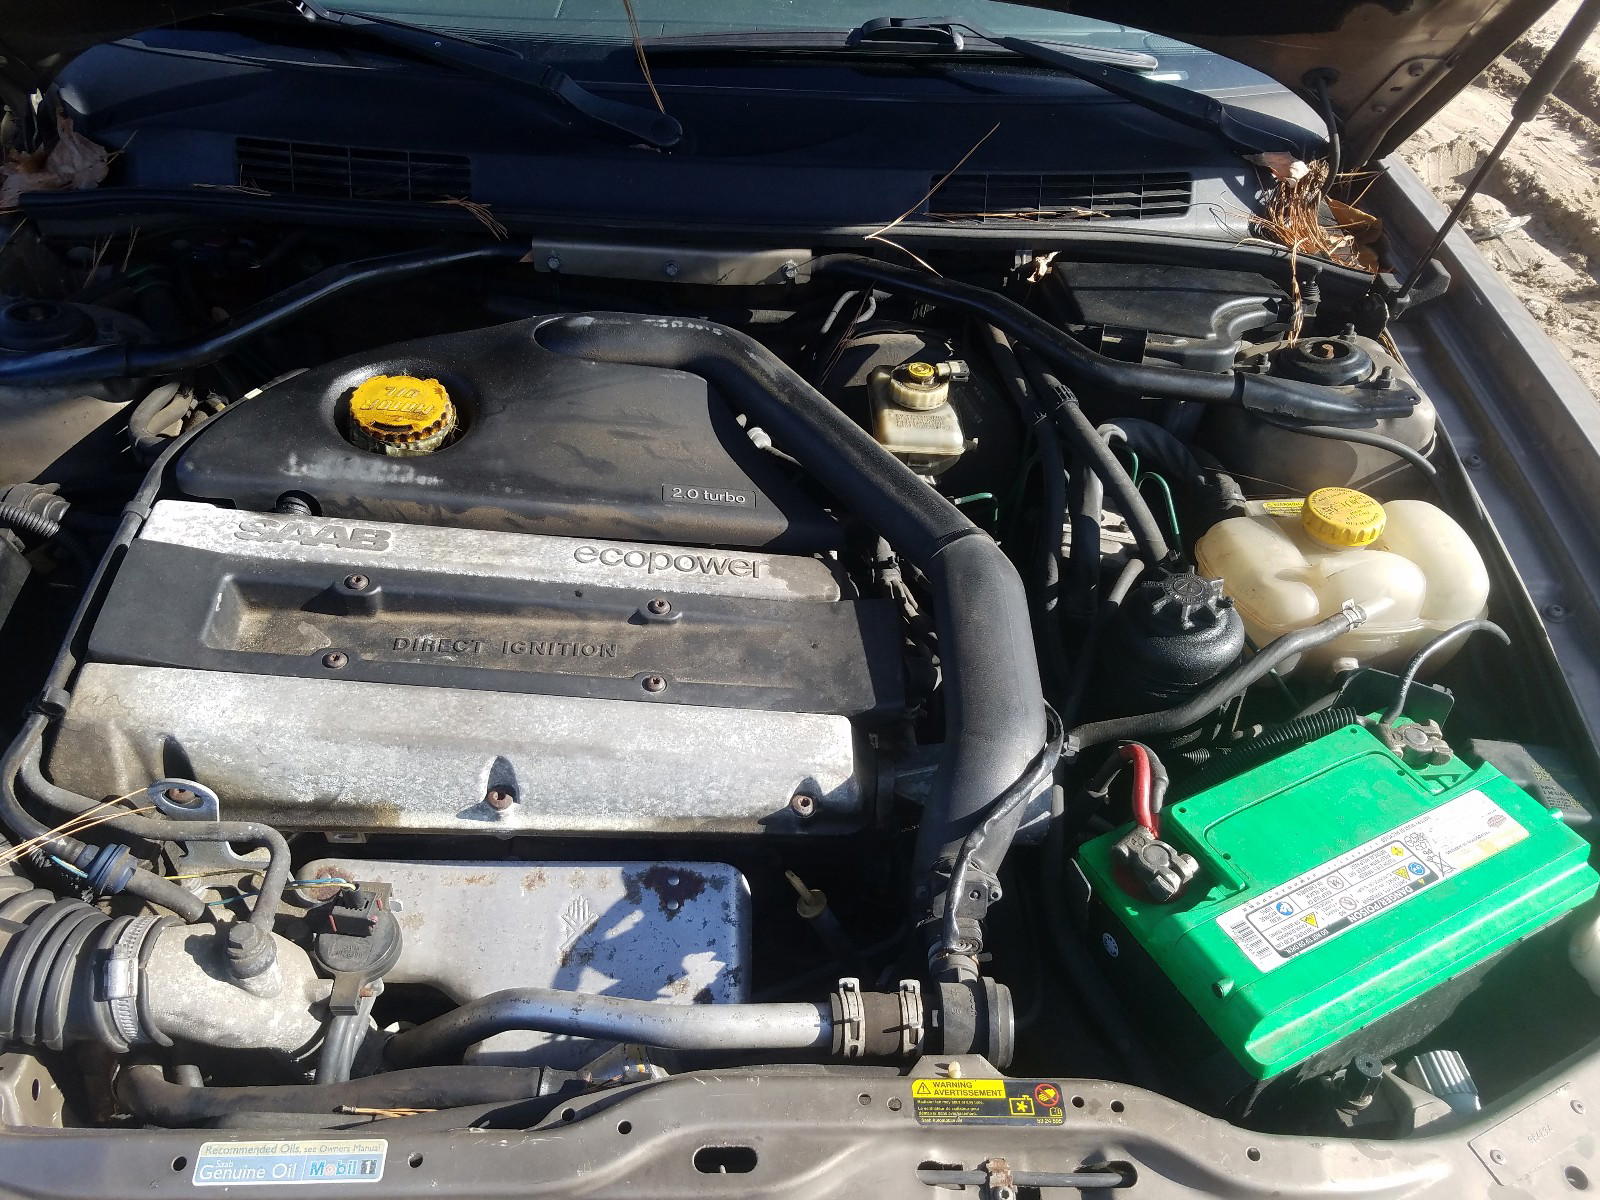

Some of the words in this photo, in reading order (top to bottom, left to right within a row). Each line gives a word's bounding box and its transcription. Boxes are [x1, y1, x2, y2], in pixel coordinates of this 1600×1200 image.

[672, 487, 699, 499] 2.0
[704, 490, 746, 503] turbo
[233, 518, 392, 551] SAAB
[573, 545, 763, 579] ecopower
[393, 637, 485, 654] DIRECT
[502, 639, 618, 658] IGNITION
[1345, 884, 1414, 922] DANGER/POISON
[932, 1081, 973, 1089] WARNING
[933, 1089, 1002, 1097] AVERTISSEMENT
[205, 1144, 277, 1155] Recommended
[303, 1145, 317, 1153] see
[353, 1143, 382, 1152] Manual
[199, 1164, 266, 1180] Genuine
[272, 1162, 297, 1179] Oil
[216, 1159, 234, 1168] Saab
[309, 1160, 358, 1176] Mobil
